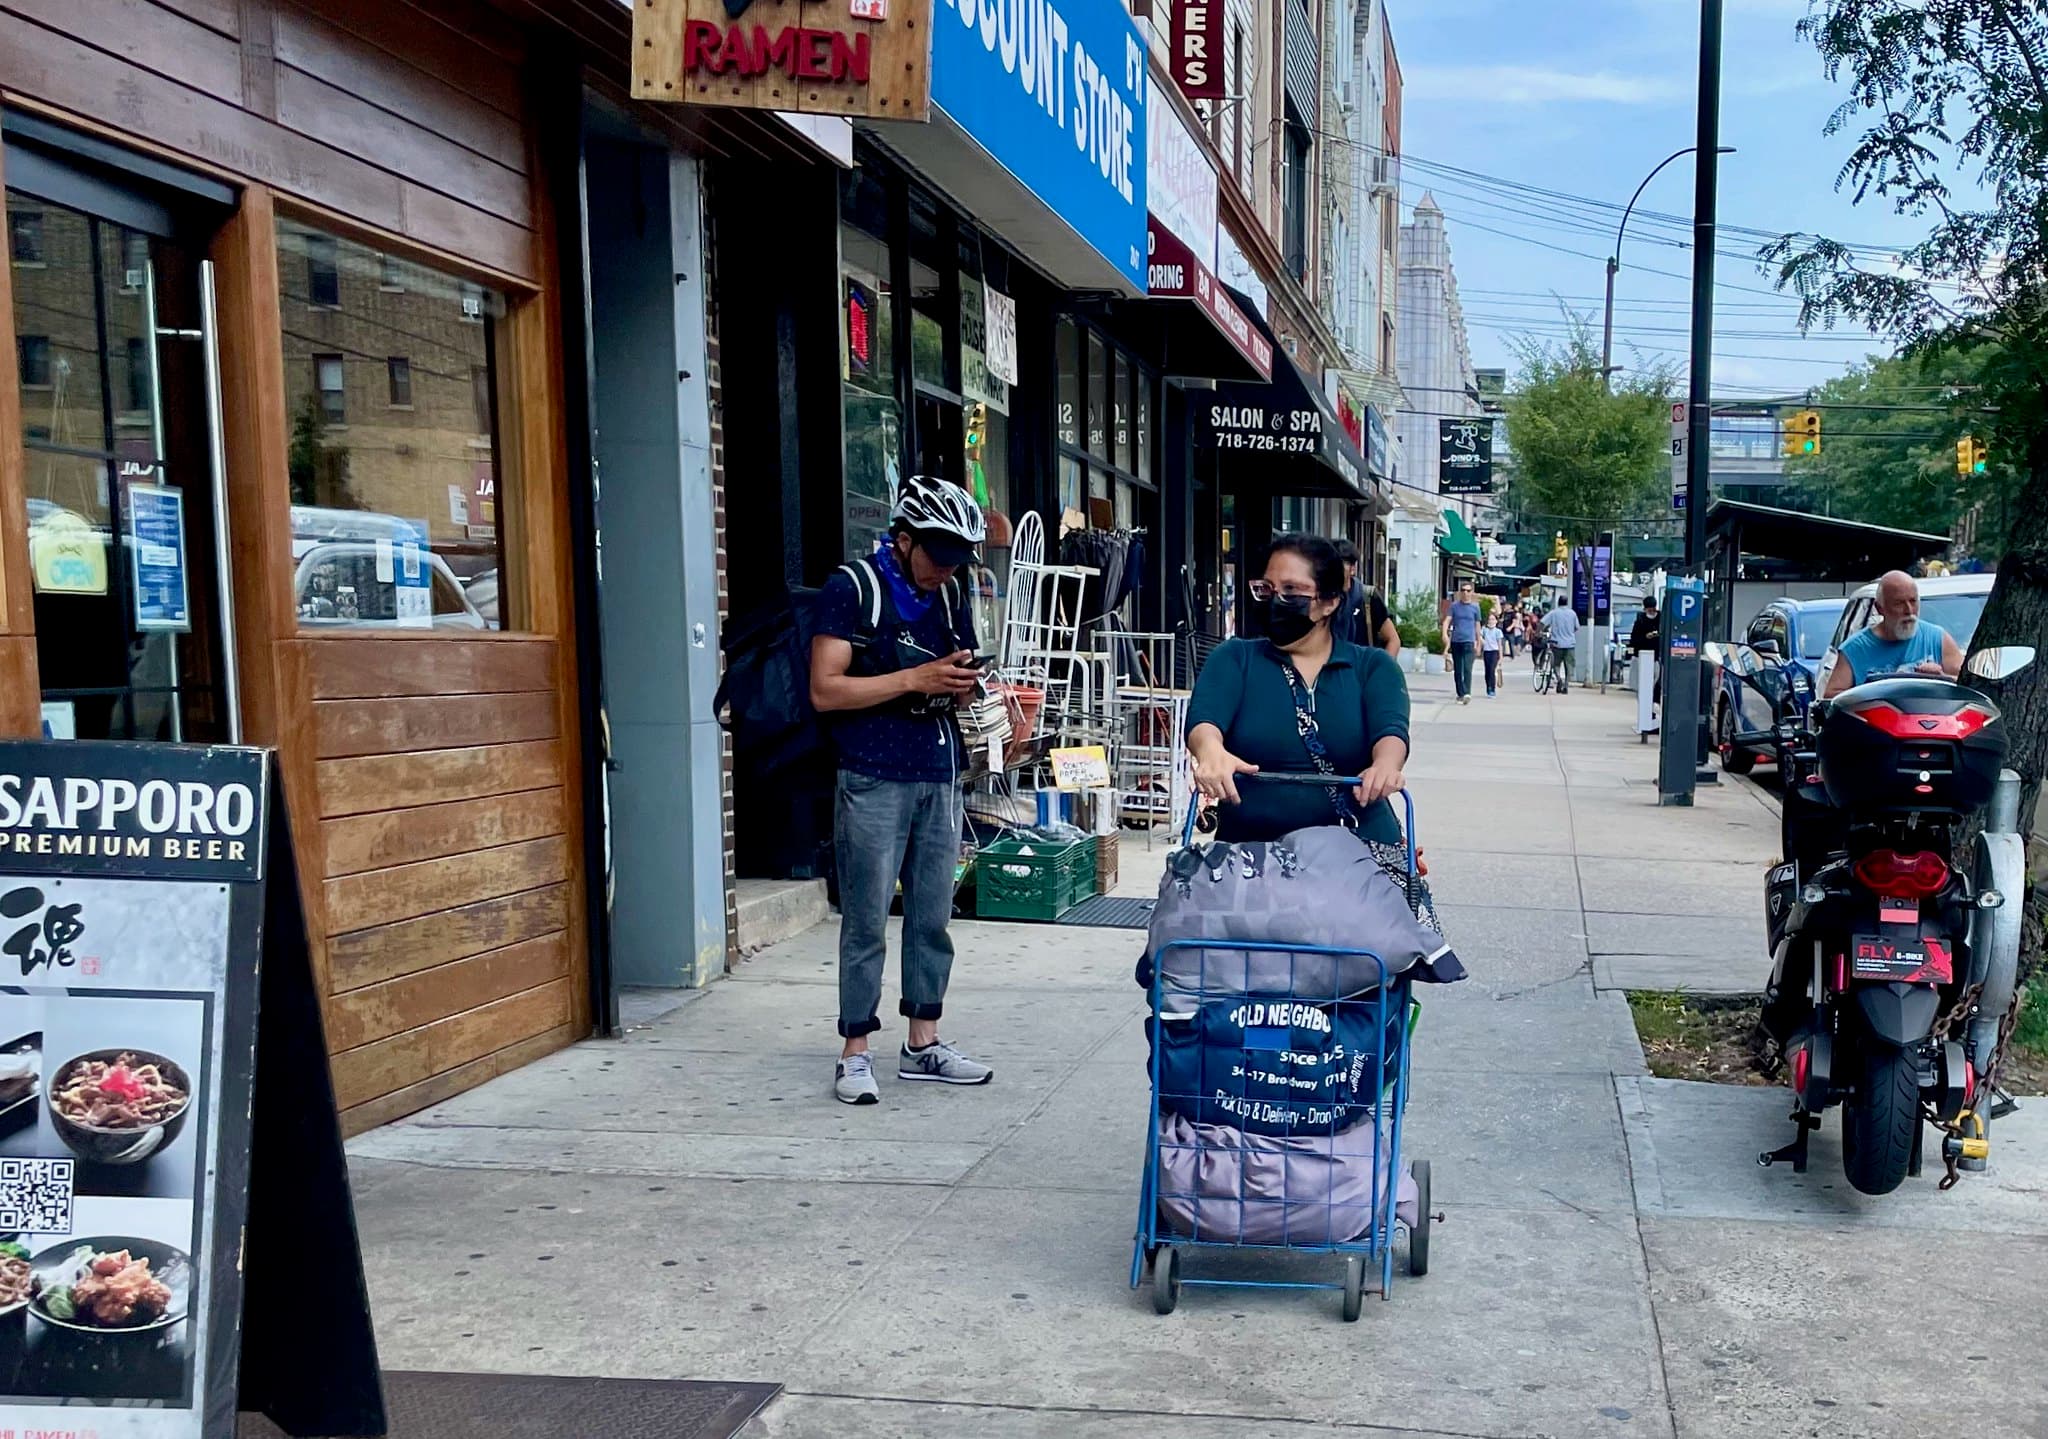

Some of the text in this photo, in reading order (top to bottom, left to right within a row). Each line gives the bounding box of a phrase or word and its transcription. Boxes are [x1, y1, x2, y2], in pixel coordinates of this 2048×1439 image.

[684, 19, 871, 85] RAMEN
[1184, 0, 1208, 86] ERS
[1074, 41, 1133, 205] STORE
[1211, 406, 1321, 433] SALON & SPA
[1216, 433, 1315, 453] 718-726-1374
[849, 505, 882, 519] OPEN
[1681, 595, 1695, 617] P
[0, 775, 253, 836] SAPPORO
[0, 833, 246, 861] PREMIUM BEER
[1858, 944, 1895, 960] FLY
[1267, 1073, 1318, 1091] Brodway
[1252, 1102, 1260, 1120] &
